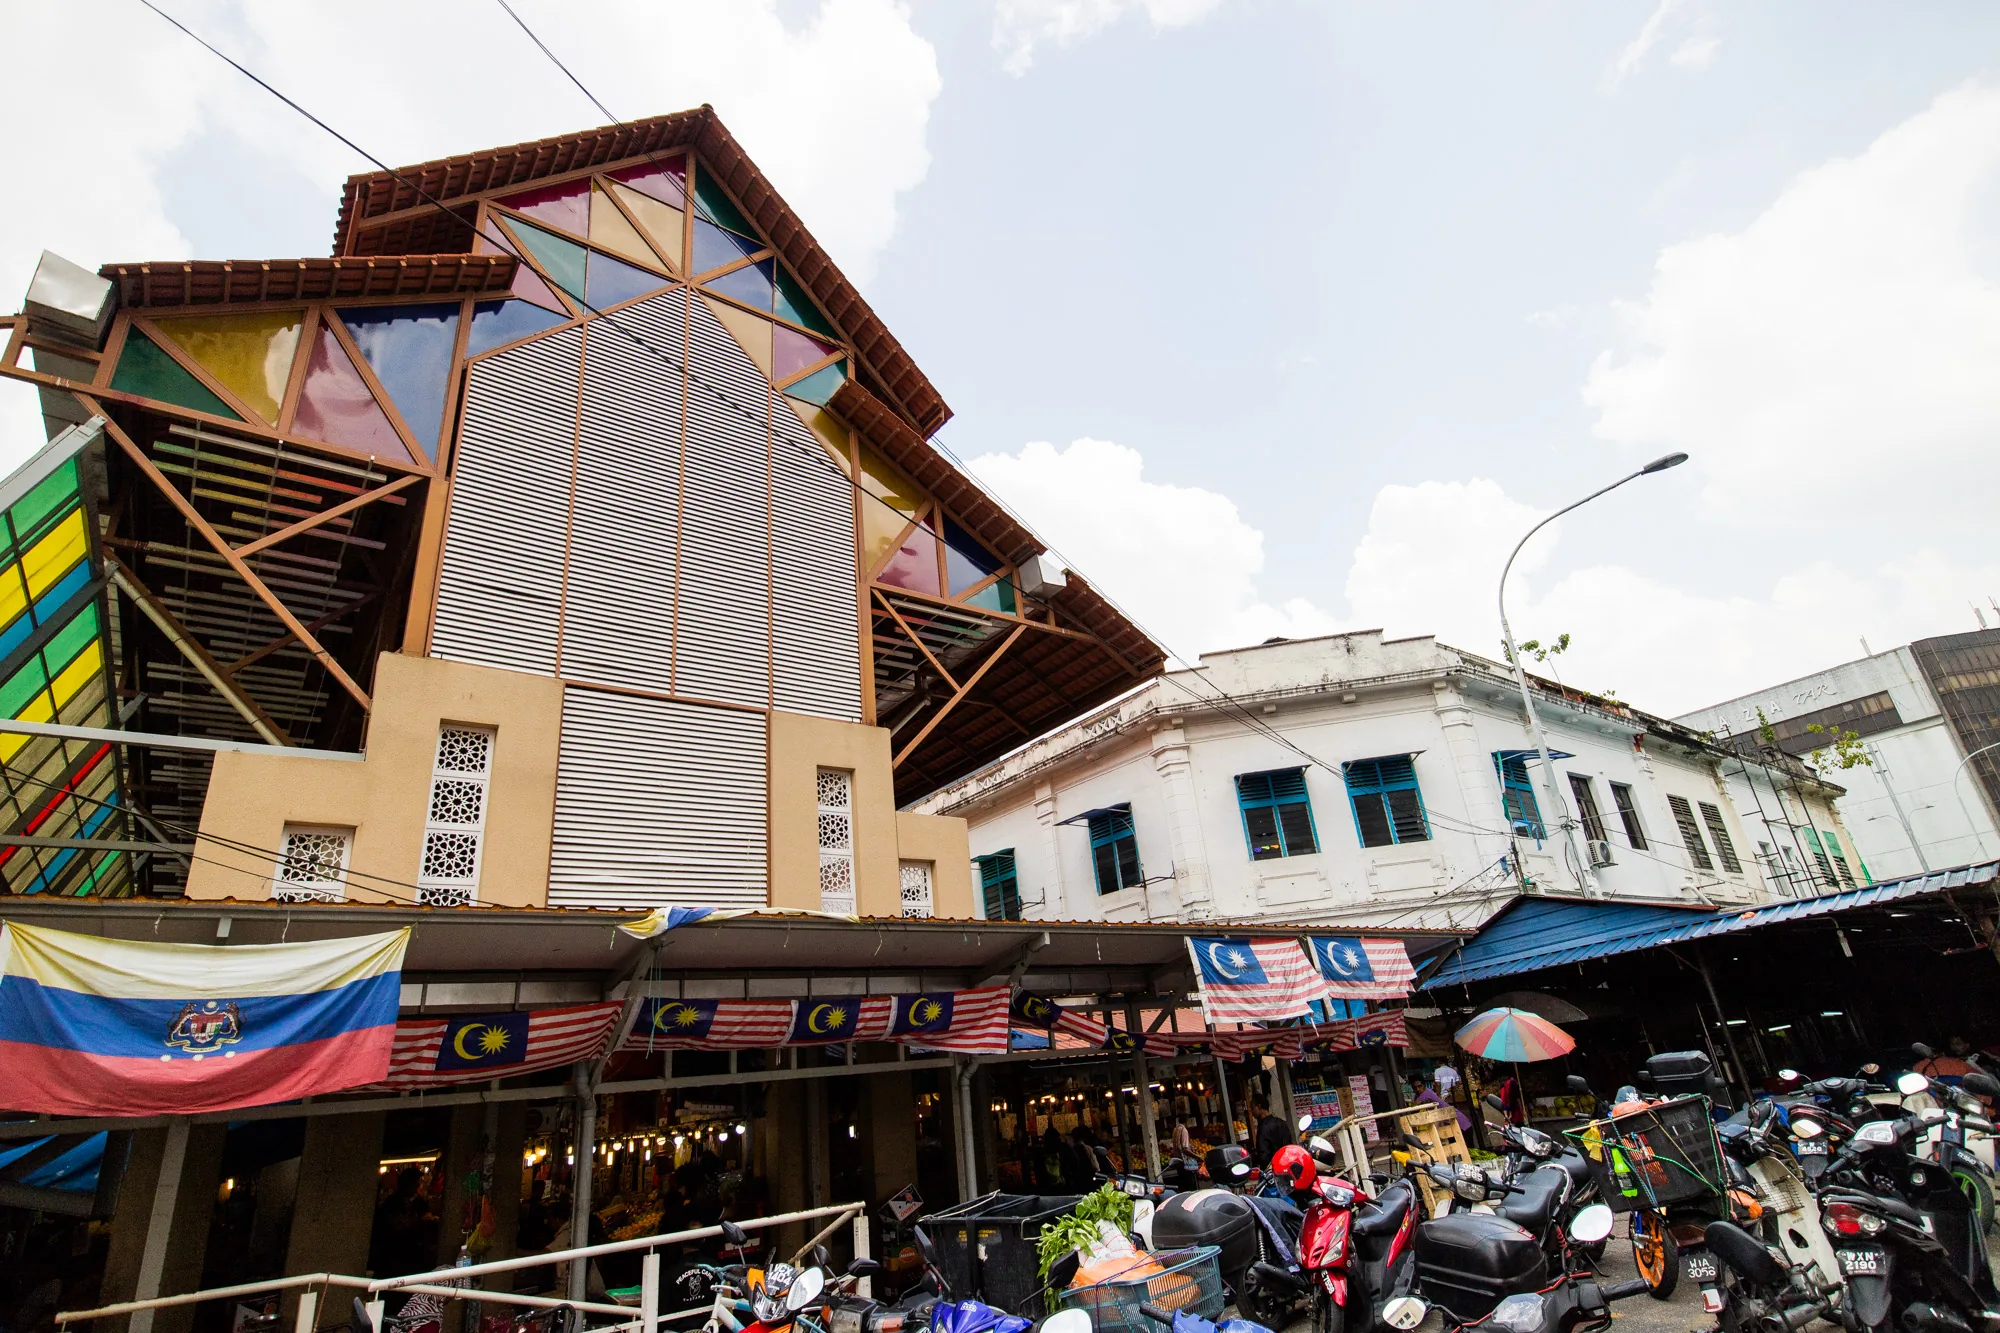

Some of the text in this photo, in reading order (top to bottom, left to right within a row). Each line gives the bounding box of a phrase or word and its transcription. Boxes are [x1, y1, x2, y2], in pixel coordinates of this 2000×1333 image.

[1792, 684, 1838, 704] TAR
[1846, 1251, 1875, 1261] WXN
[1845, 1260, 1877, 1270] 2190
[767, 1270, 793, 1287] 1404
[1703, 1293, 1719, 1310] L
